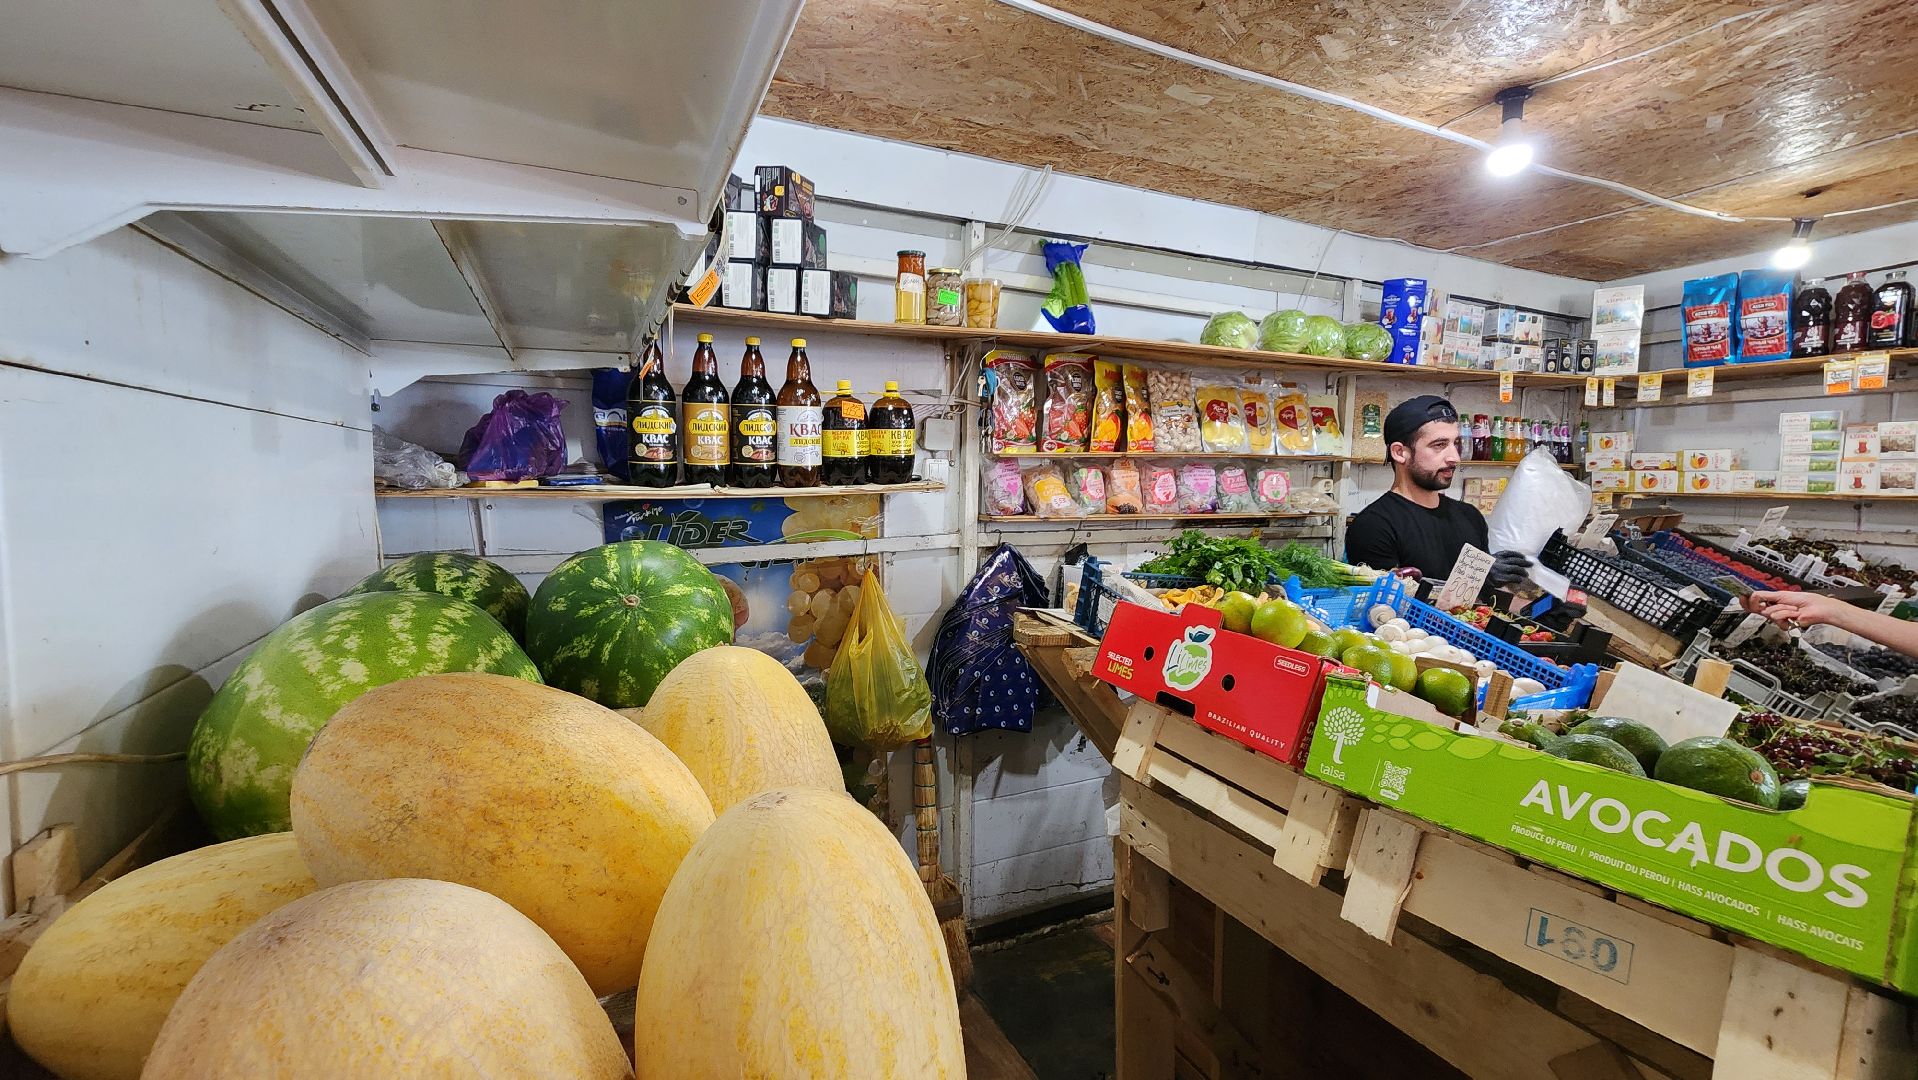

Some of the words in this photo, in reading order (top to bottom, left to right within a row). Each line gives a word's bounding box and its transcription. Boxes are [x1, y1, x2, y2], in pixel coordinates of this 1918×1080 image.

[636, 421, 672, 431] ЛИДСКИ
[891, 430, 912, 440] КВАС
[642, 434, 669, 443] КВАС
[698, 436, 724, 445] КВАС
[748, 436, 773, 445] КВАС
[1107, 651, 1133, 667] SELECTED
[1277, 659, 1307, 672] SEEDLESS
[1107, 660, 1134, 680] LIMES
[1207, 711, 1247, 733] BRAZILIAN
[1249, 729, 1286, 749] QUALITY
[1511, 825, 1545, 842] PRODUCE
[1545, 836, 1557, 846] OF
[1557, 840, 1578, 853] PERU
[1520, 779, 1871, 909] AVOCADOS
[1588, 851, 1625, 869] PRODUIT
[1625, 863, 1639, 874] DU
[1640, 868, 1671, 885] PEROU
[1678, 880, 1703, 897] HASS
[1703, 890, 1760, 916] AVOCADOS
[1777, 914, 1808, 932] HASS
[1808, 925, 1865, 951] AVOCATS
